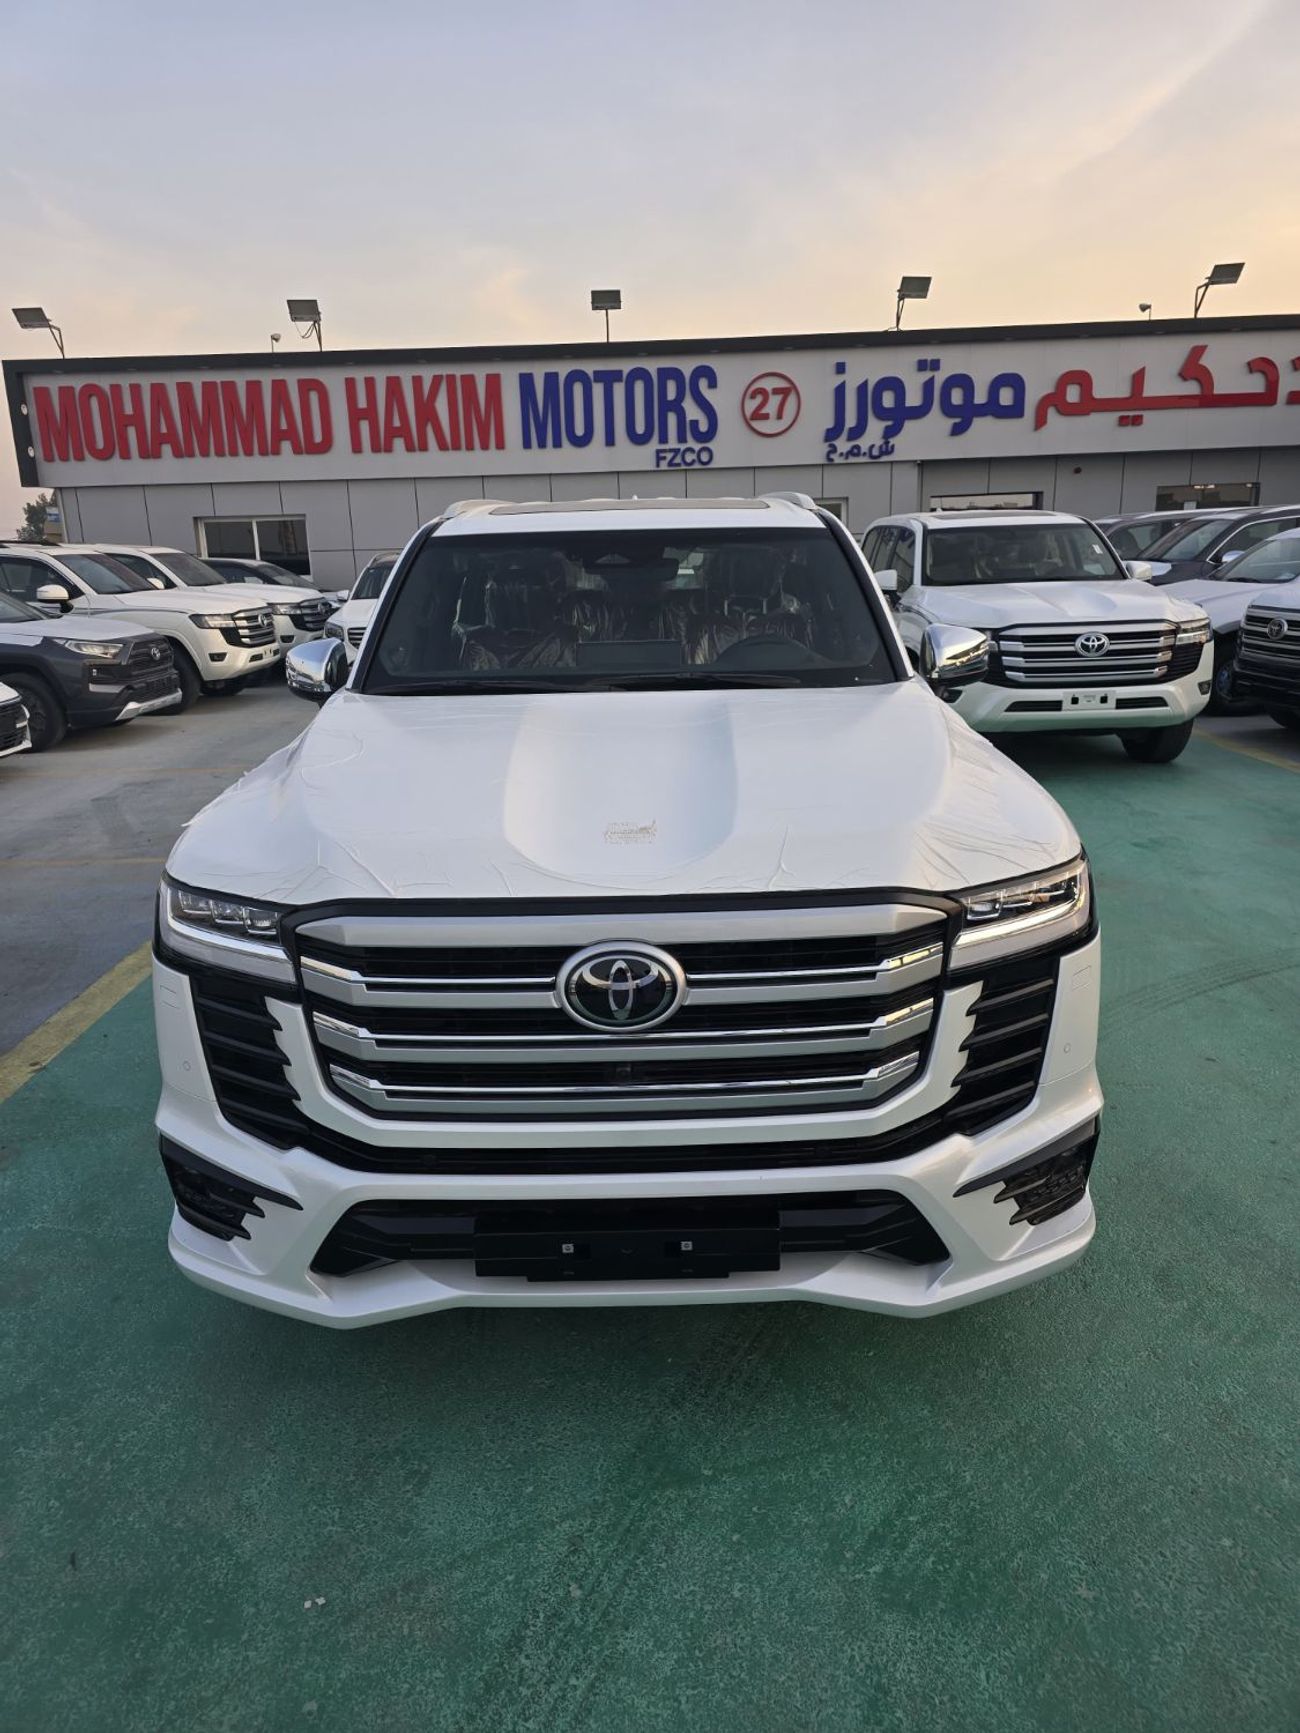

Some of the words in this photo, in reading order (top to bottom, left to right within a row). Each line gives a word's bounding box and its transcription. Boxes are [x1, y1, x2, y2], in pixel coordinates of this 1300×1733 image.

[33, 378, 334, 462] MOHAMMAD
[345, 374, 505, 453] HAKIM
[519, 364, 718, 449] MOTORS
[749, 386, 792, 421] 27
[824, 359, 1026, 442] موتورز
[1034, 344, 1280, 431] حكيم
[655, 446, 713, 468] FZCO
